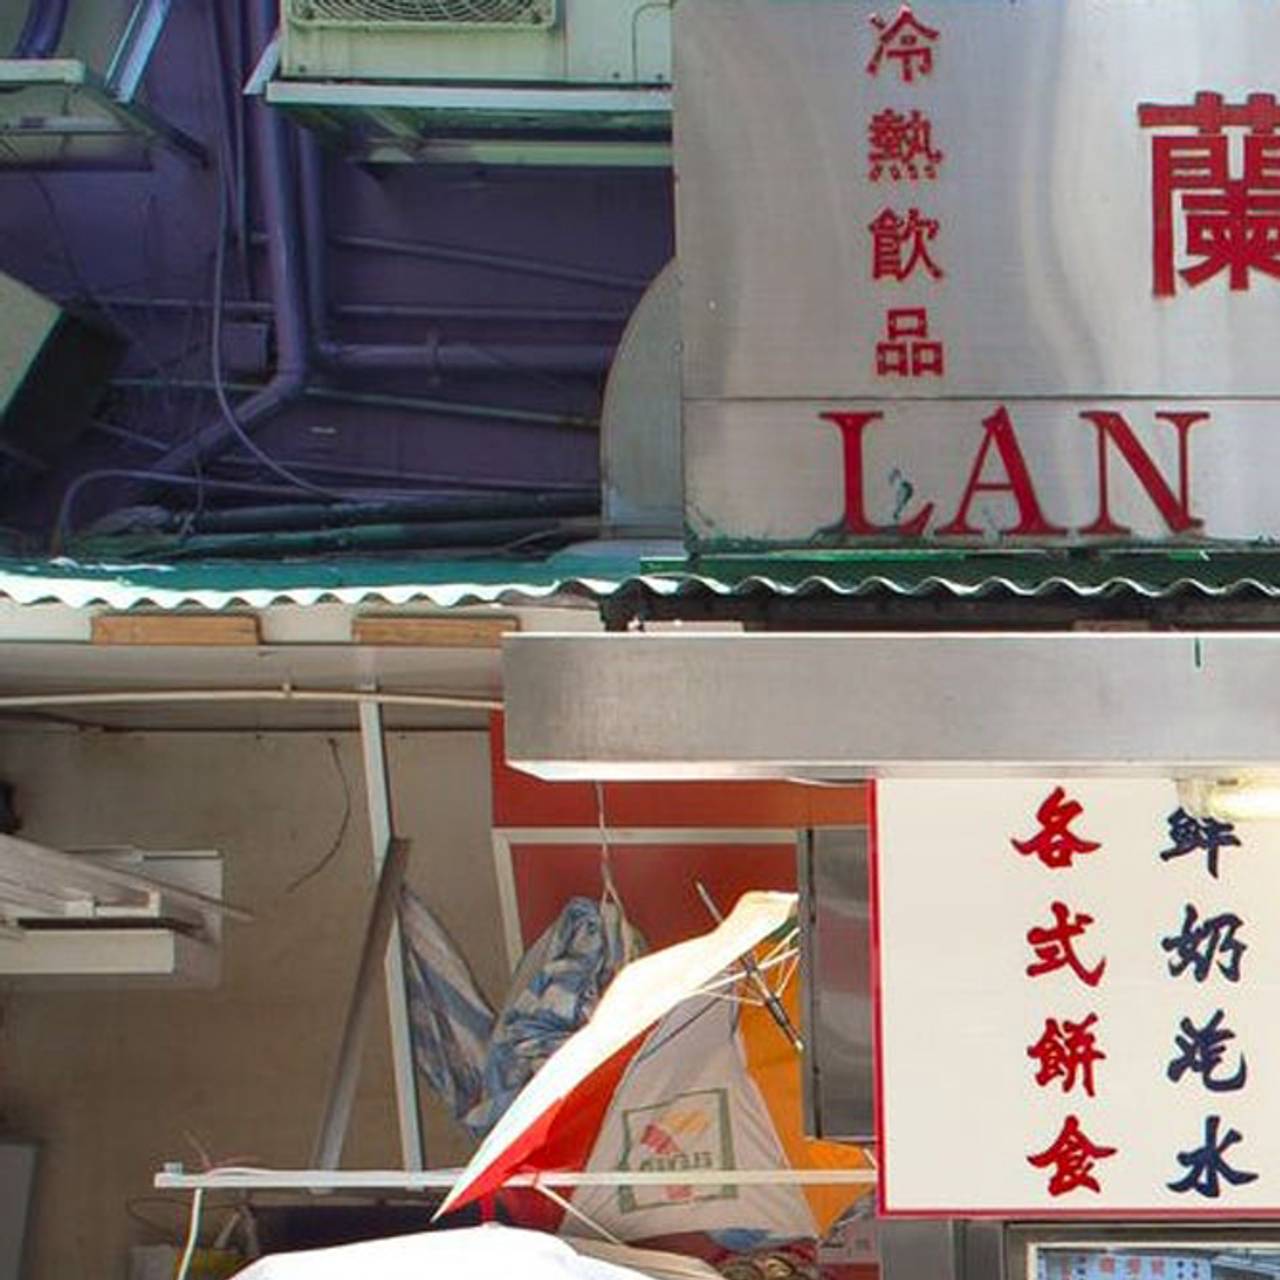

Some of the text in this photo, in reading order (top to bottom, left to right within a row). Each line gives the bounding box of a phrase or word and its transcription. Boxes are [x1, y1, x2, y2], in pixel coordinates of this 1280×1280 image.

[865, 3, 944, 378] 冷熱飲品
[819, 405, 1211, 538] LAN
[1010, 786, 1117, 1196] 各式餅食
[1158, 806, 1259, 1198] 鮮奶汽水
